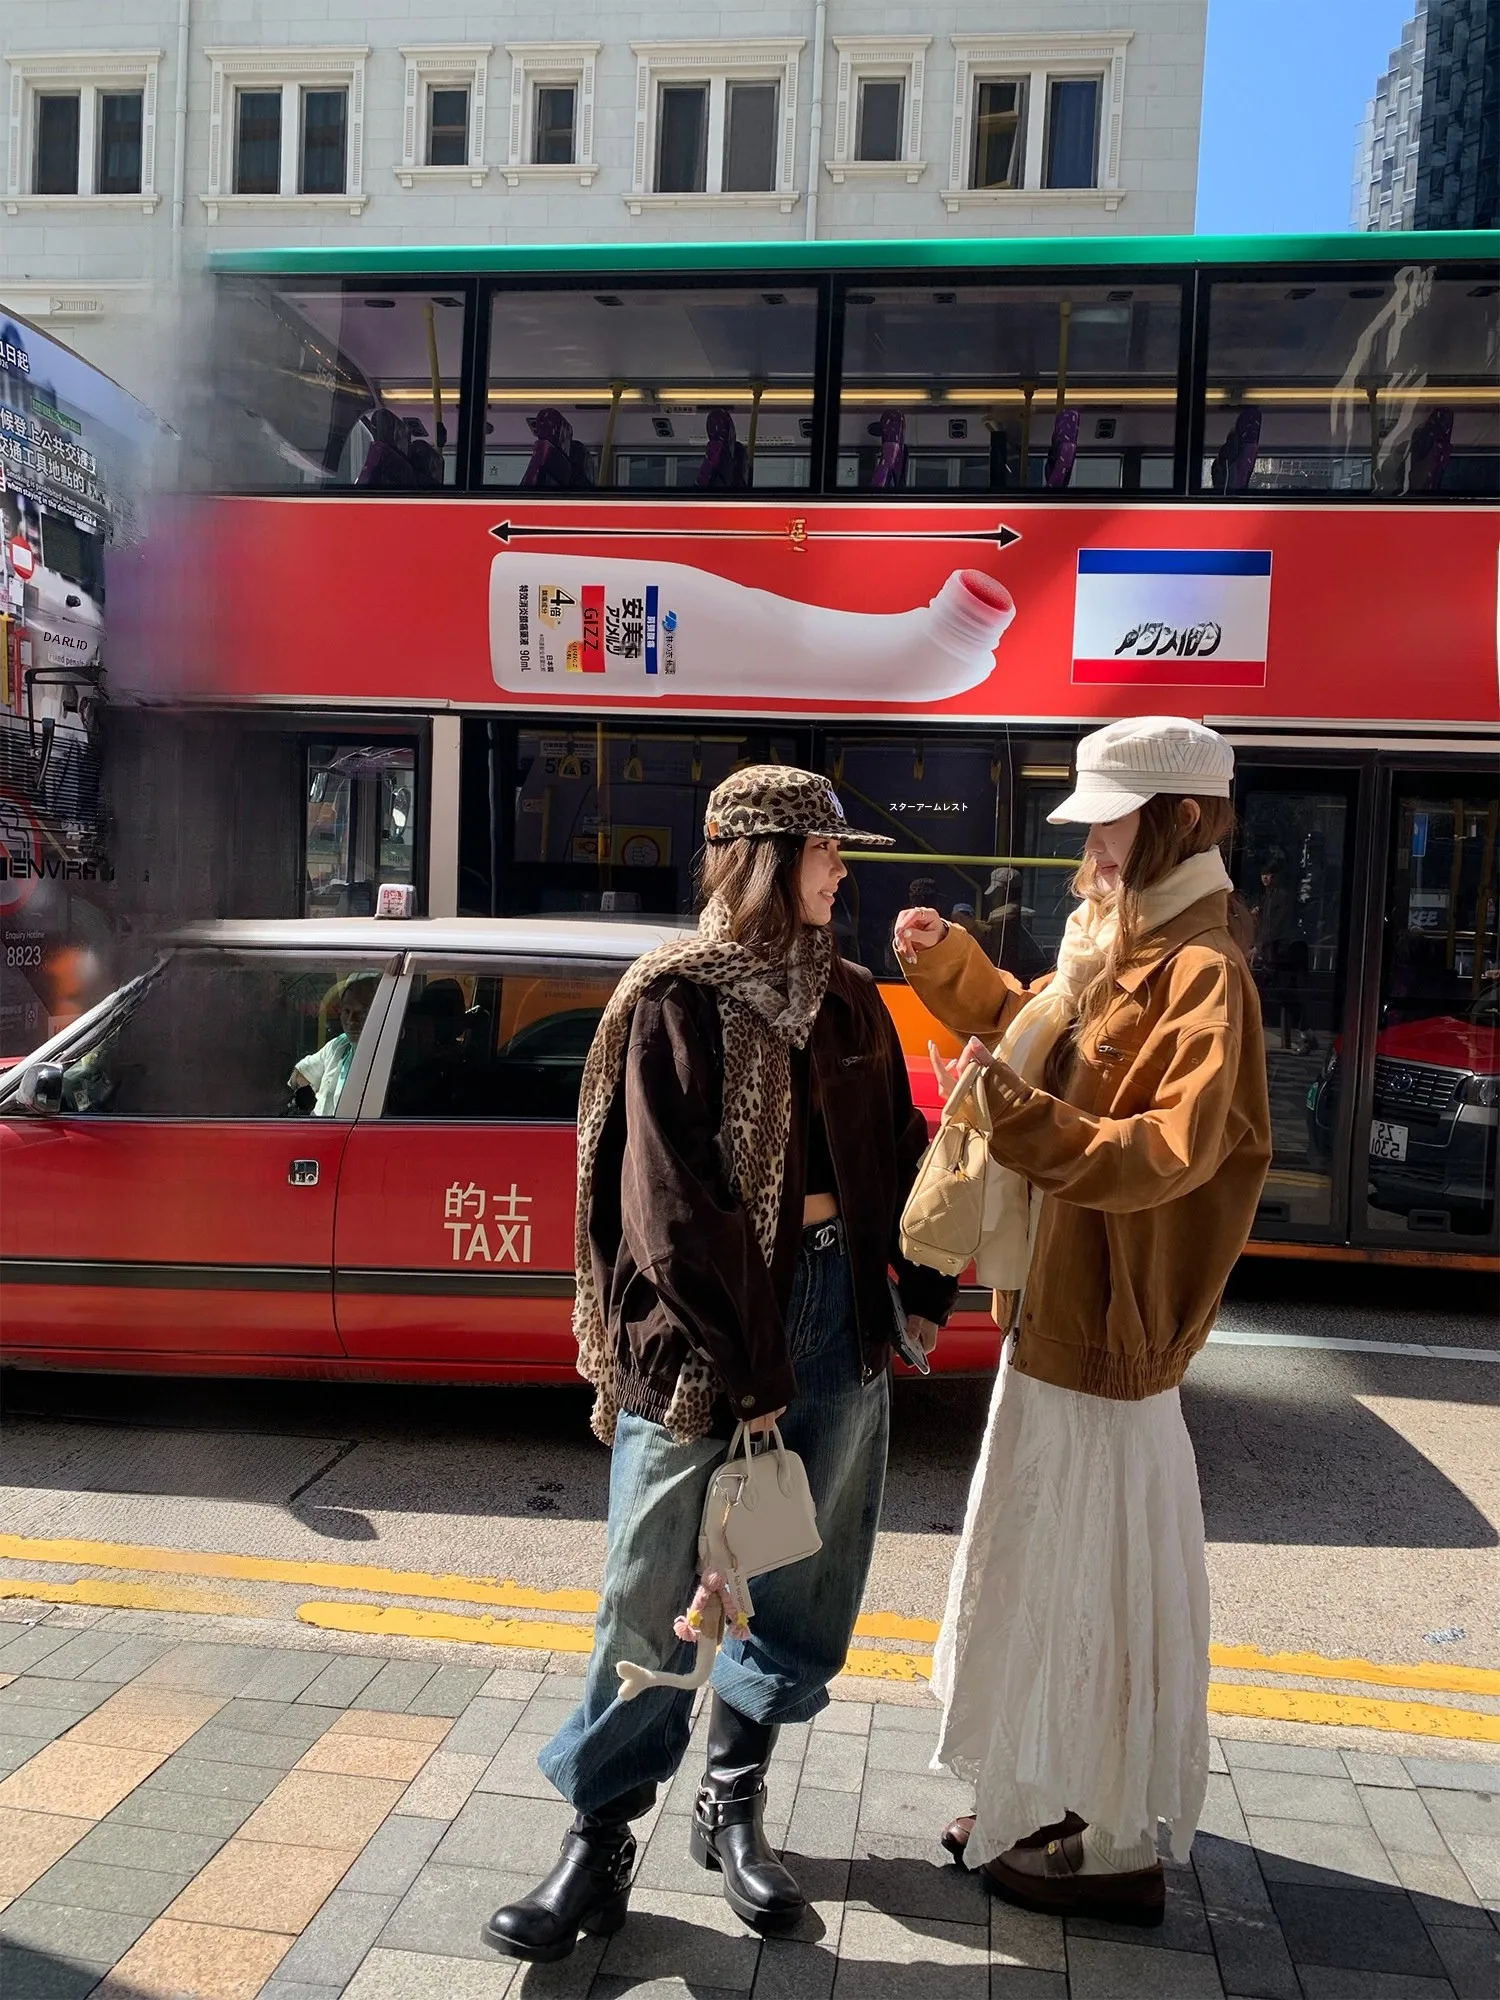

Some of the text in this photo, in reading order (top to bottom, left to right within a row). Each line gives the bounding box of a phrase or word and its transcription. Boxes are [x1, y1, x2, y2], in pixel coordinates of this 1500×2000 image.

[7, 480, 22, 494] when
[23, 487, 42, 505] staying
[43, 631, 88, 651] DARLID
[606, 605, 620, 656] アンメルツ
[519, 650, 531, 672] 90mL
[889, 802, 969, 813] スターアームレスト
[5, 930, 45, 941] Enquiry Hotline
[7, 945, 42, 967] 8823
[444, 1181, 533, 1222] 的士
[443, 1222, 532, 1263] TAXI
